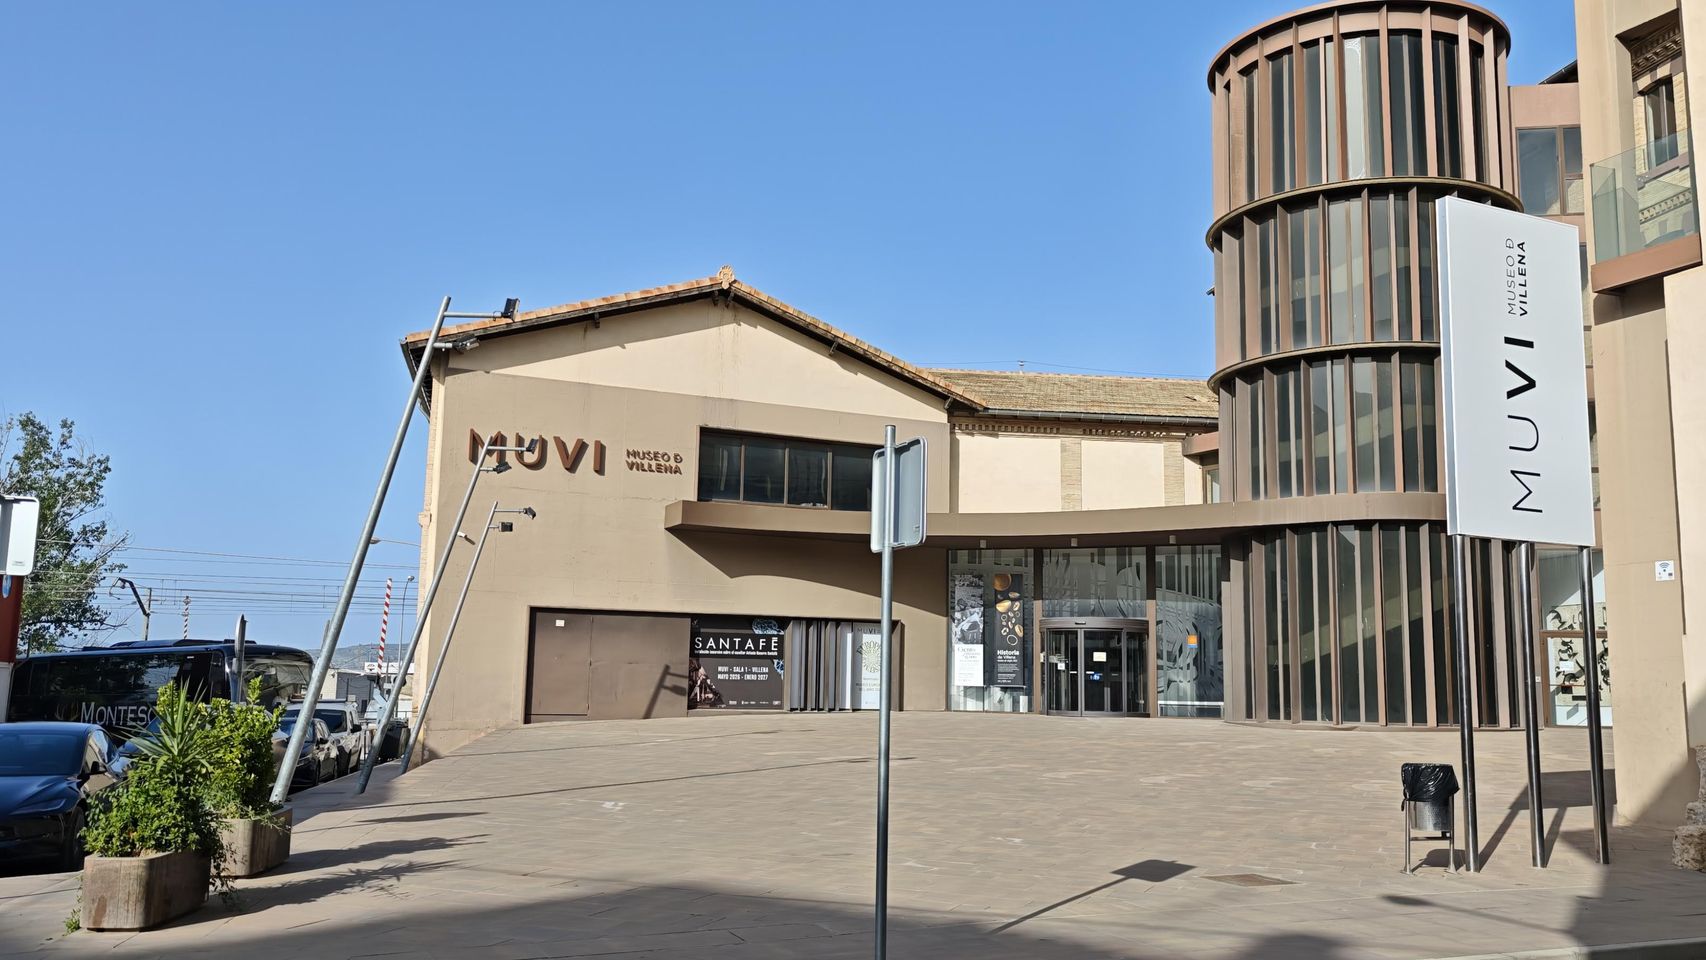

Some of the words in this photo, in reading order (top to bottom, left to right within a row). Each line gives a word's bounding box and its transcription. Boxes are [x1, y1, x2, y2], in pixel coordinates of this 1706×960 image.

[1505, 255, 1517, 315] MUSEO
[1516, 241, 1528, 317] VILLENA
[1504, 336, 1543, 513] MUVI
[469, 428, 605, 476] MUVI
[625, 460, 682, 475] VILLENA
[626, 449, 671, 462] MUSEO
